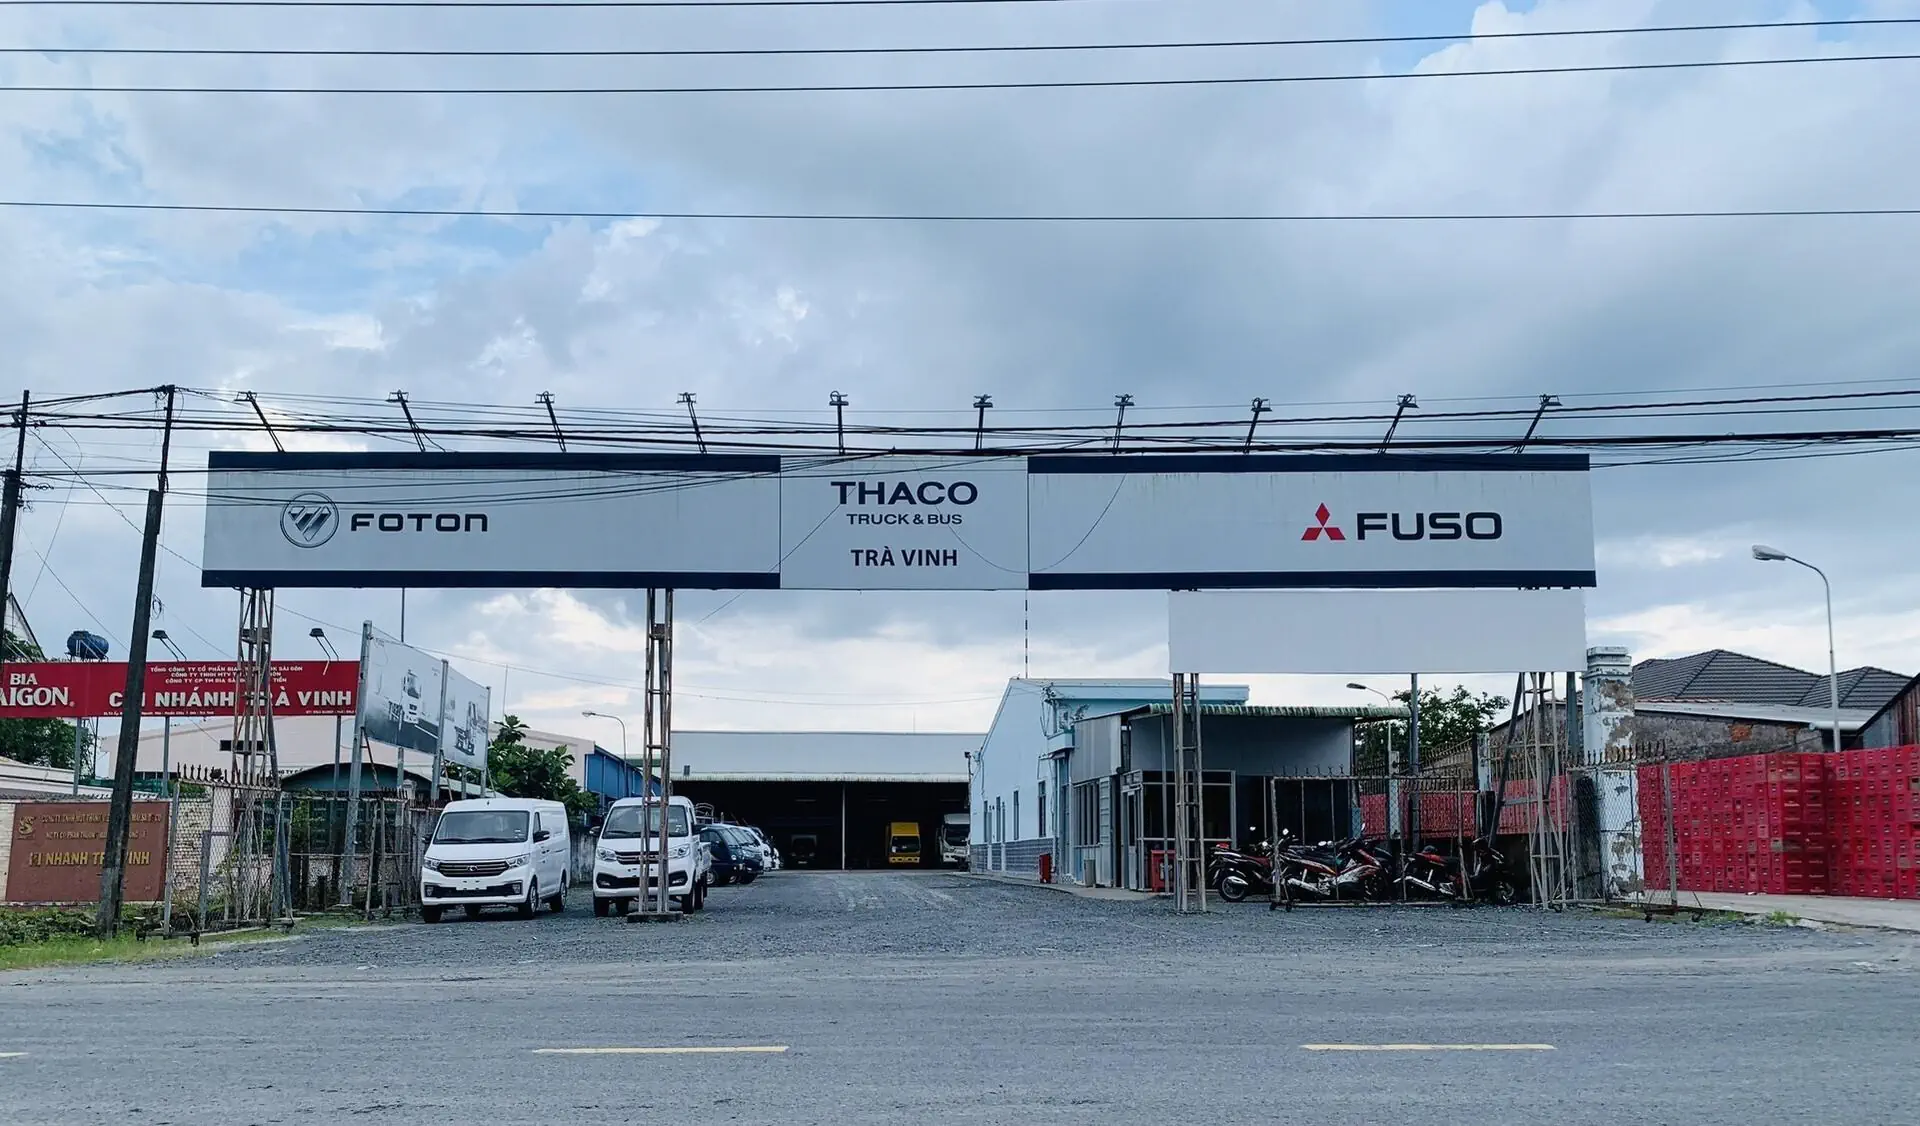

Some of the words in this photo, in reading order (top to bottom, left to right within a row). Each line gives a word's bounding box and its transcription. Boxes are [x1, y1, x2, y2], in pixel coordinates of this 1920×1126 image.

[830, 481, 978, 505] THACO
[350, 513, 488, 532] FOTON
[846, 514, 910, 525] TRUCK
[912, 514, 924, 525] &
[928, 514, 963, 525] BUS
[1357, 511, 1502, 541] FUSO
[850, 546, 896, 567] TRÀ
[901, 549, 958, 567] VINH
[10, 673, 38, 685] BIA
[155, 686, 234, 707] NHÁNH
[297, 690, 352, 707] VINH
